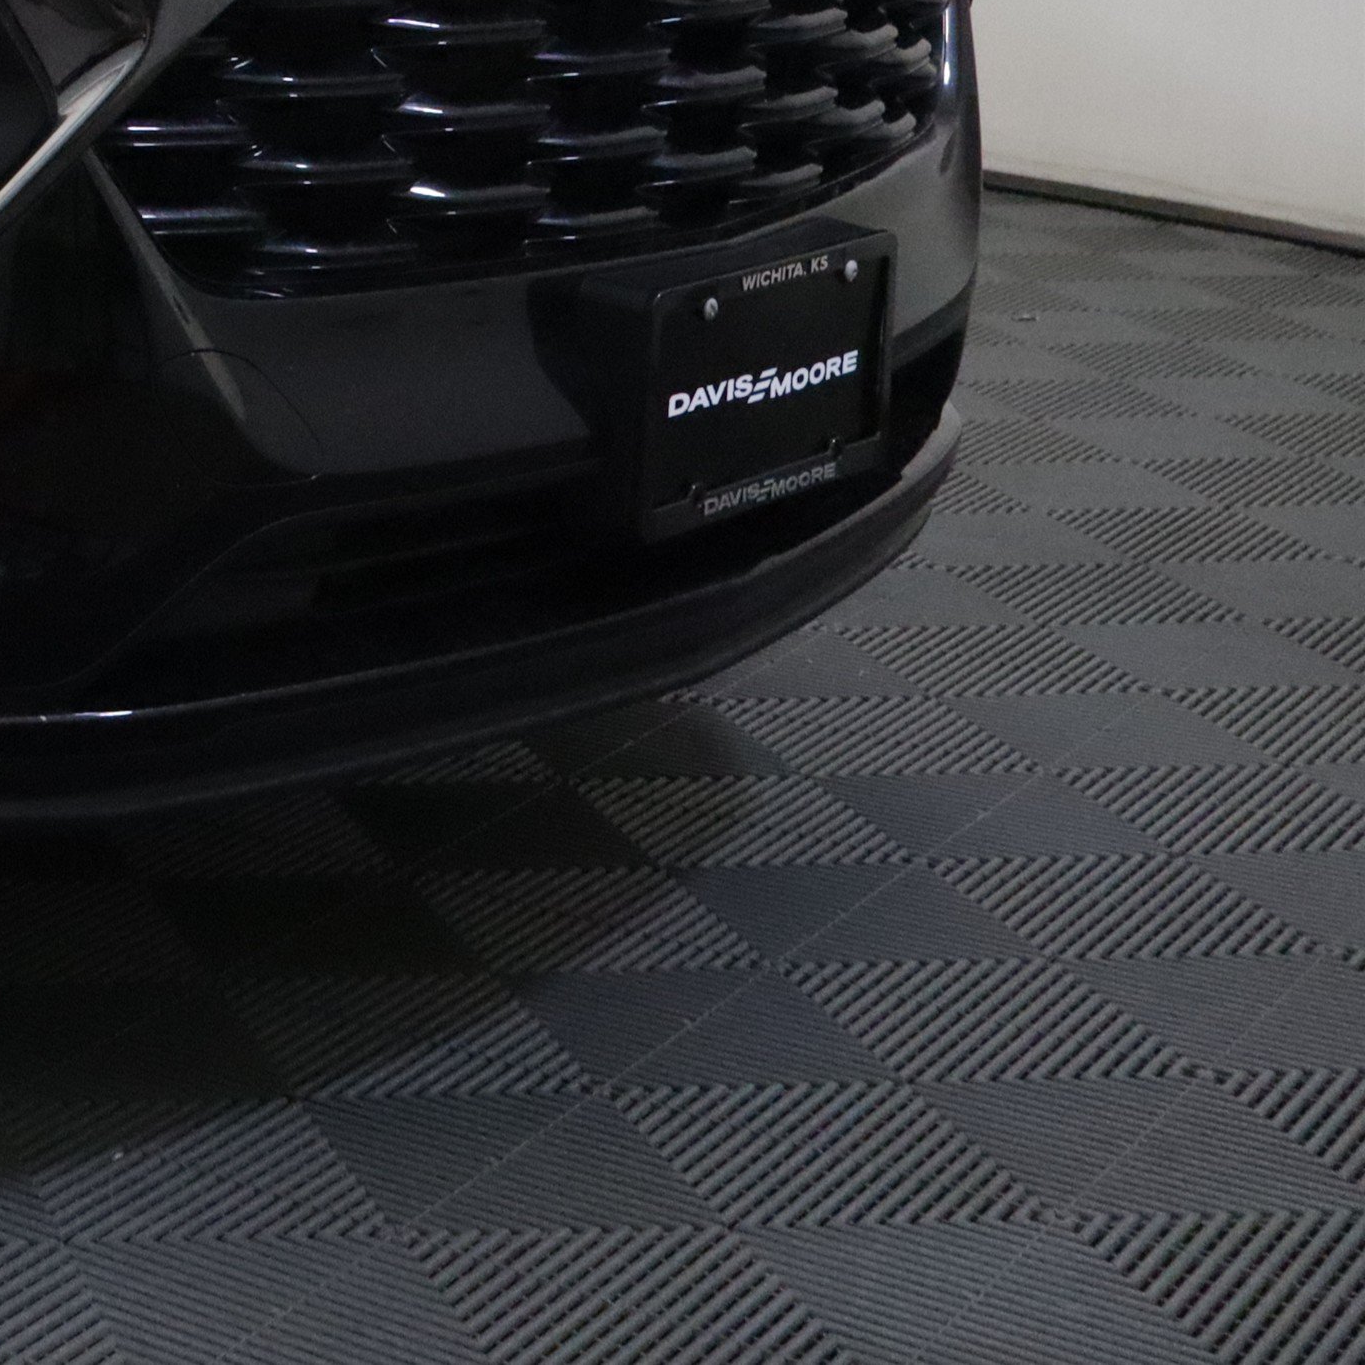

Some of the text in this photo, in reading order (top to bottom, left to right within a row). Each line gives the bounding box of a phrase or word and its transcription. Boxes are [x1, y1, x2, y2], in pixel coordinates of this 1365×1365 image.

[810, 255, 829, 274] KS
[668, 349, 859, 418] DAVIS MOORE
[703, 461, 838, 516] DAVIS MOORE
